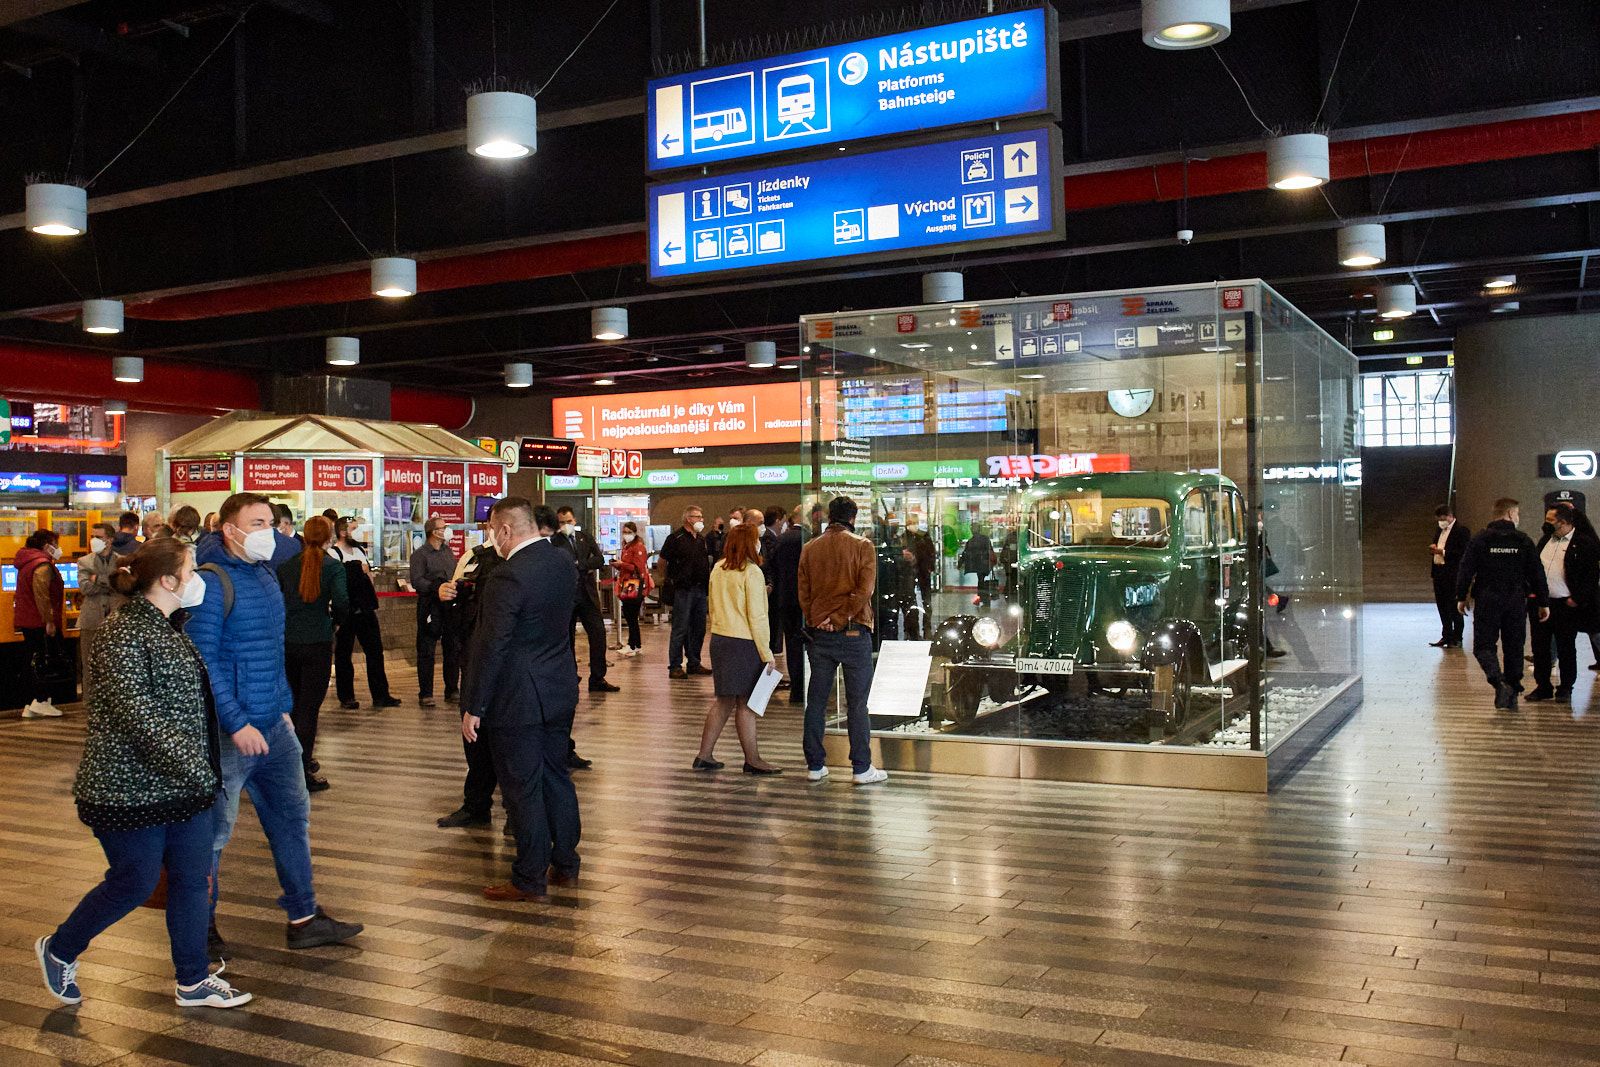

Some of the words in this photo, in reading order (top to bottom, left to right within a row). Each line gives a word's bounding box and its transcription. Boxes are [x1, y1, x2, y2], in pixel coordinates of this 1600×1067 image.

[879, 22, 1028, 71] Nástupiště
[878, 72, 944, 93] Platforms
[879, 89, 955, 111] Bahnsteige
[964, 152, 990, 161] Policie
[757, 176, 810, 195] Jízdenky
[758, 195, 781, 203] Tickets
[758, 202, 794, 212] Fahrkarten
[904, 197, 956, 217] Východ
[942, 214, 956, 222] Exit
[926, 223, 956, 233] Ausgang
[601, 405, 671, 421] Radiožurnál
[673, 405, 686, 419] je
[689, 402, 715, 418] díky
[718, 401, 745, 415] Vám
[602, 420, 710, 440] nejposlouchanější
[713, 418, 746, 431] rádio
[629, 455, 640, 476] C
[934, 466, 963, 474] Lékárna
[391, 469, 421, 484] Metro
[436, 471, 461, 485] Tram
[479, 472, 498, 486] Bus
[697, 472, 729, 481] Pharmacy
